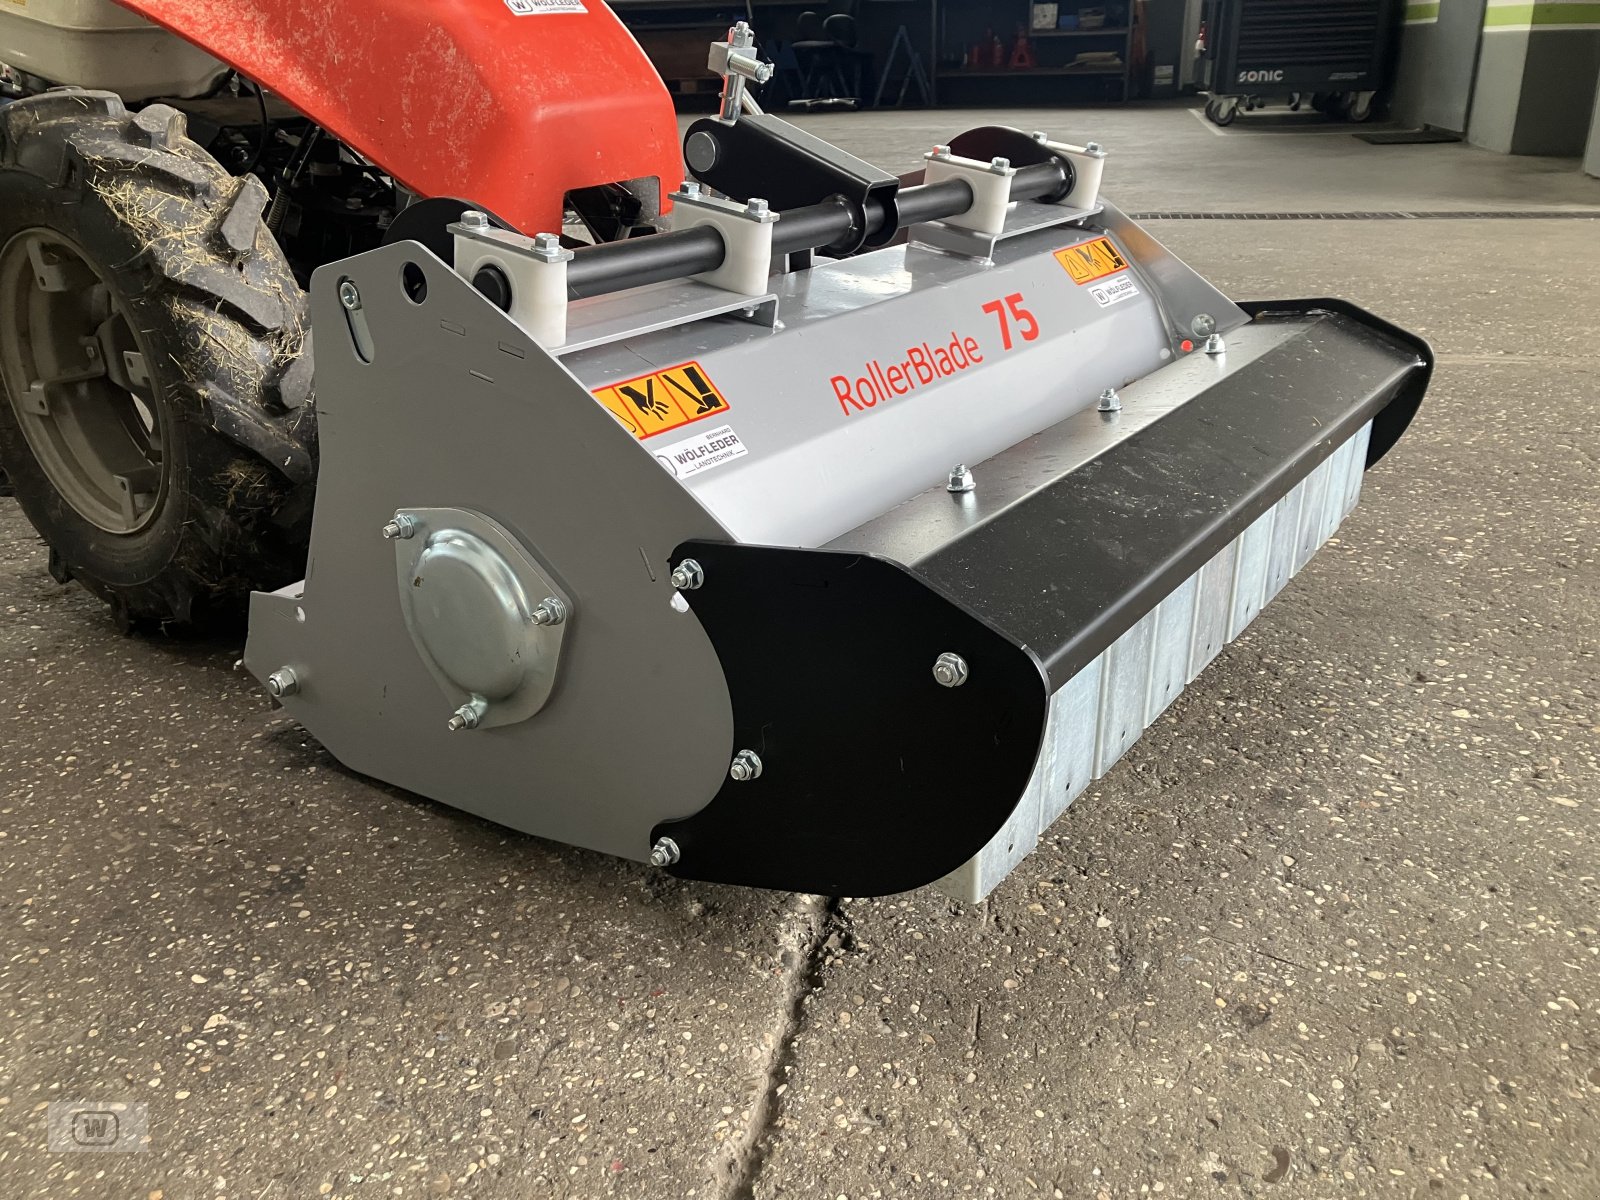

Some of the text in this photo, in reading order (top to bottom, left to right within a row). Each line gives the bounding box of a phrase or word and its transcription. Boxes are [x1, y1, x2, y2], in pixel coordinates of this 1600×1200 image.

[512, 1, 526, 9] W
[830, 292, 1040, 416] RollerBlade 75
[705, 427, 732, 440] BERNHARD
[674, 434, 740, 465] WÖLFLEDER
[694, 449, 736, 470] LANDTECHNIK
